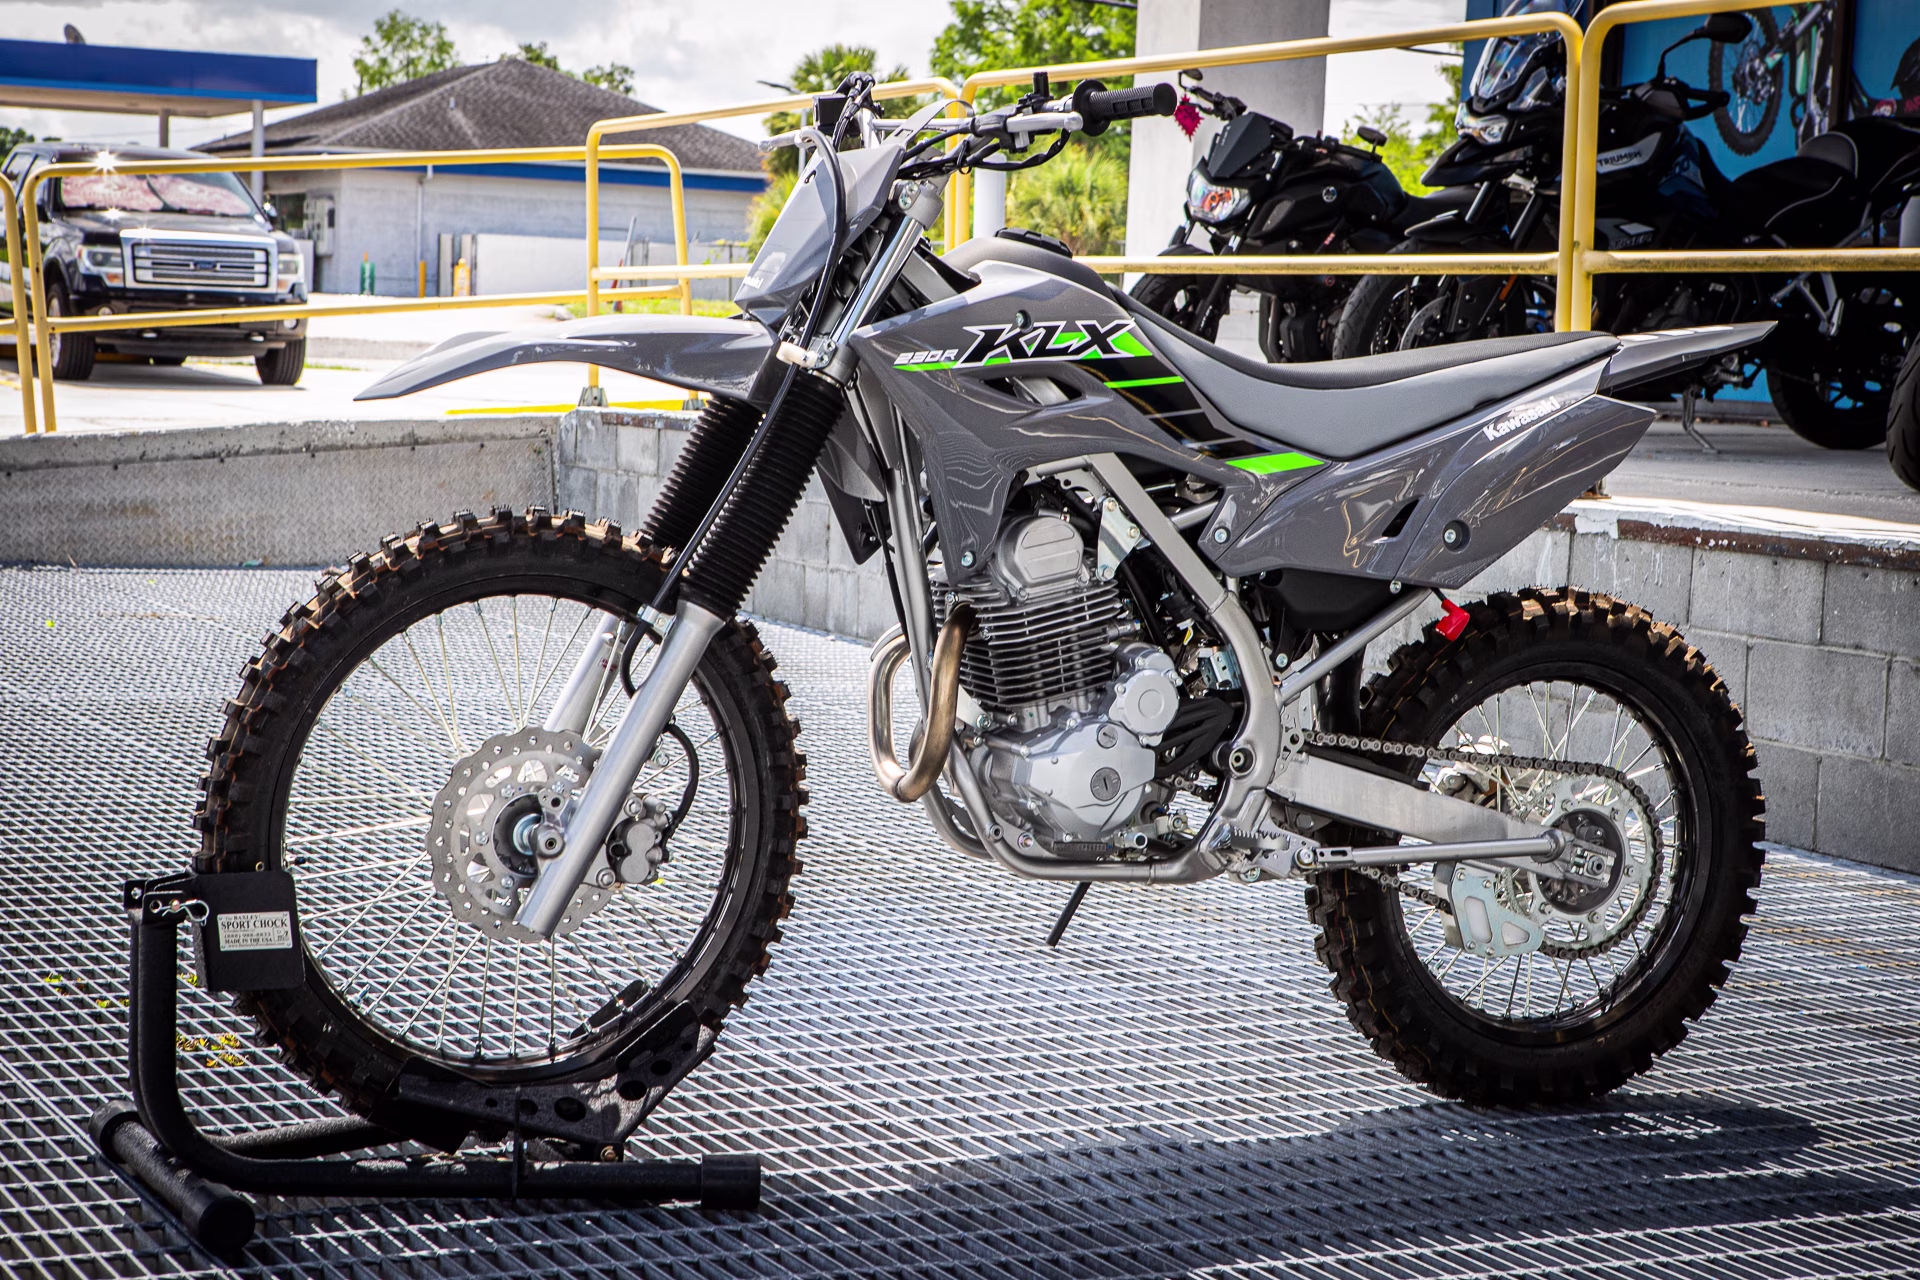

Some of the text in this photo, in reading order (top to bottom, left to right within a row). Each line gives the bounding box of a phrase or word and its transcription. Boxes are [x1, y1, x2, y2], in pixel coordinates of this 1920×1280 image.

[1598, 150, 1642, 167] TRIUMPH
[893, 319, 1136, 369] 230R KLX
[1482, 396, 1561, 441] Kawasaki
[221, 918, 288, 930] SPORT CHOCK
